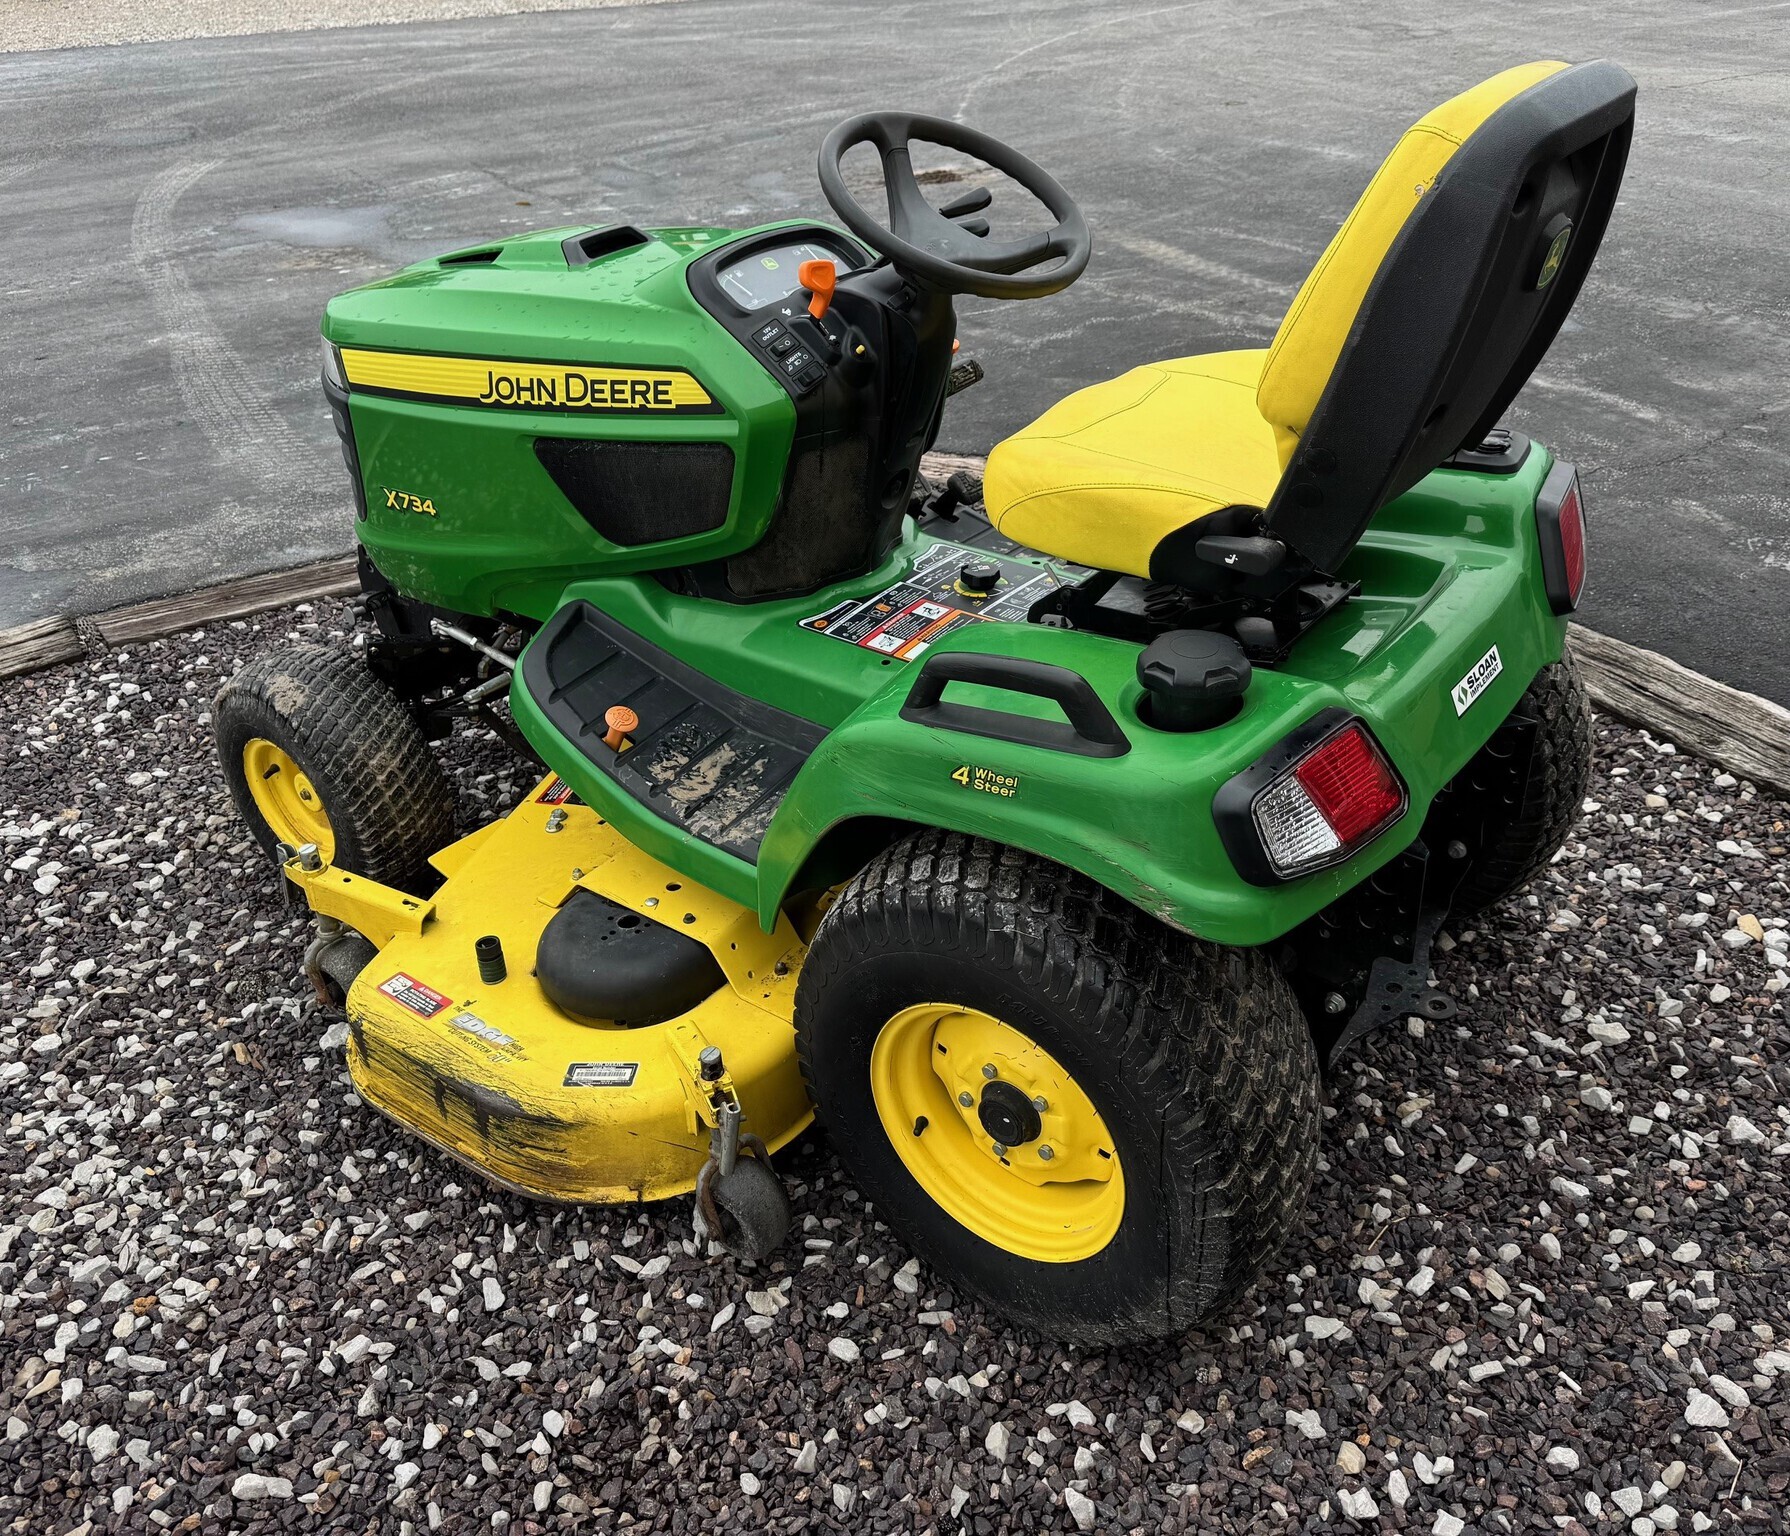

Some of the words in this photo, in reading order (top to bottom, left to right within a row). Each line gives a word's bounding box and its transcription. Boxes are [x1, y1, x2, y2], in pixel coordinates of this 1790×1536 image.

[785, 351, 802, 365] LIGHTS
[479, 370, 557, 403] JOHN
[564, 372, 673, 406] DEERE
[382, 487, 437, 517] X734
[1466, 650, 1498, 690] SLOAN
[1469, 662, 1500, 699] IMPLEMENT
[951, 765, 970, 786] 4
[974, 766, 1019, 788] Wheel
[973, 778, 1016, 798] Steer
[448, 1011, 516, 1046] EDGE
